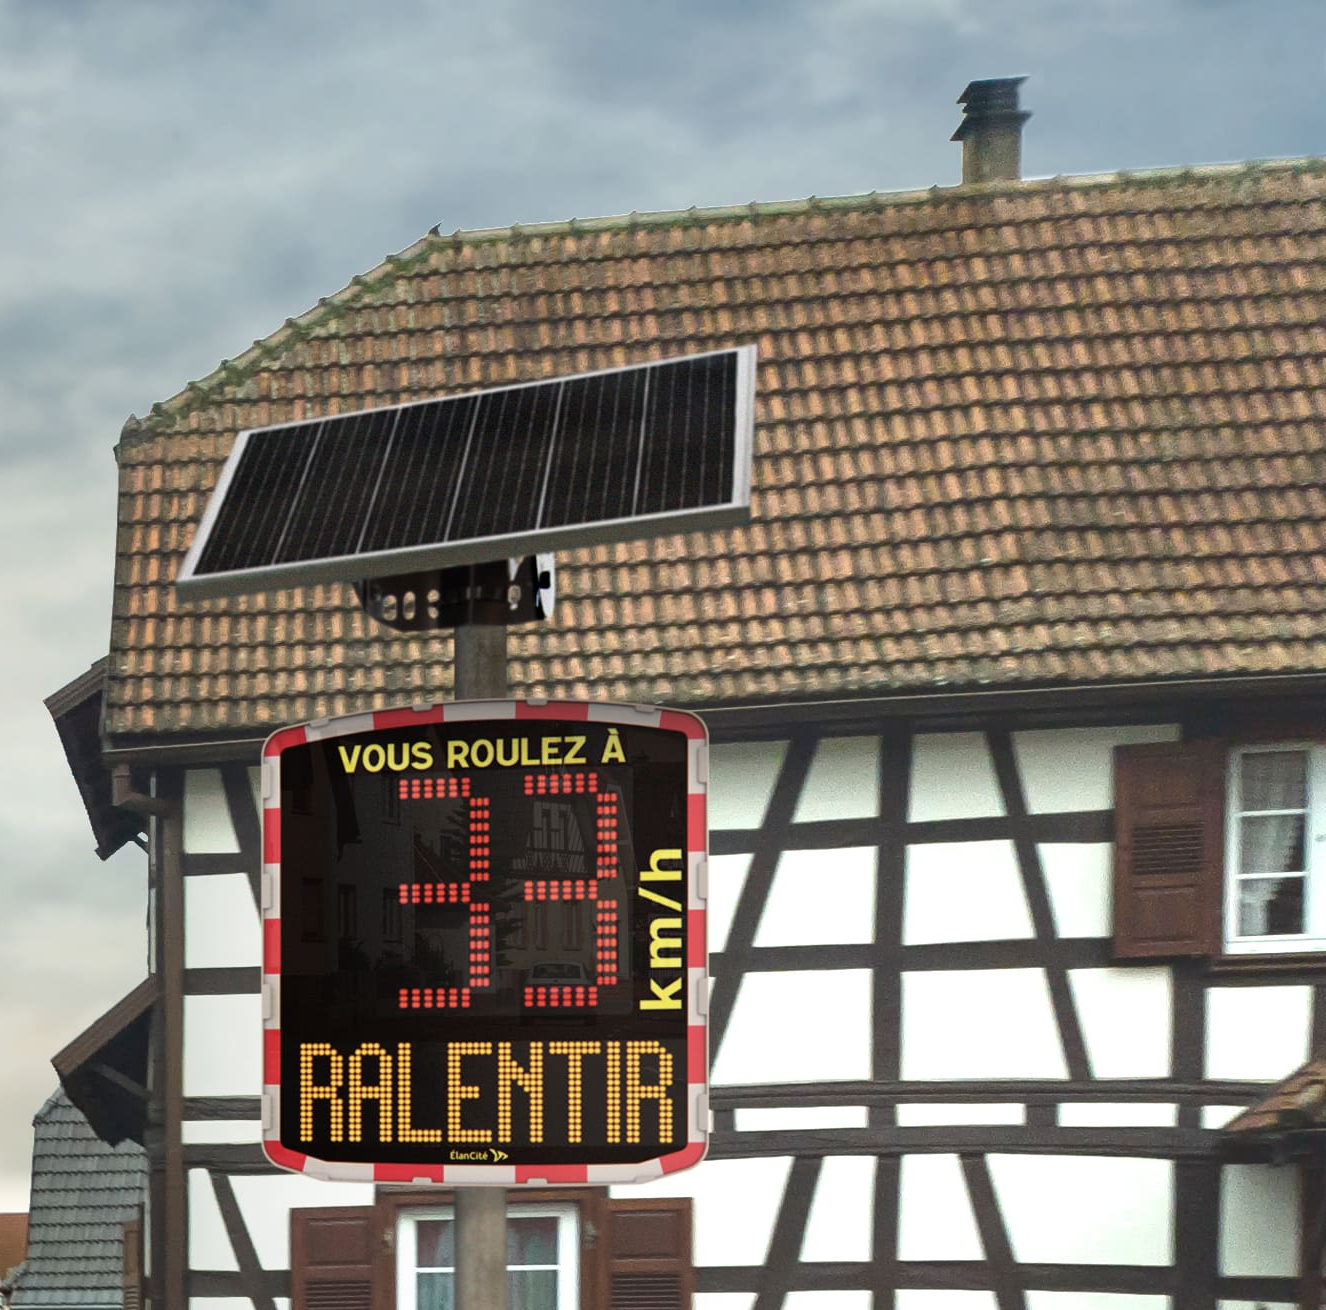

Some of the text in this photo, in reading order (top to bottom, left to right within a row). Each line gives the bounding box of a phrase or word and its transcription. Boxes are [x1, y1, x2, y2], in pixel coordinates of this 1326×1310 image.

[338, 728, 626, 774] VOUS ROULEZ À
[399, 772, 618, 1009] 33
[637, 848, 683, 1010] km/h
[299, 1040, 673, 1144] RALENTIR
[449, 1149, 489, 1161] ÉlanCité
